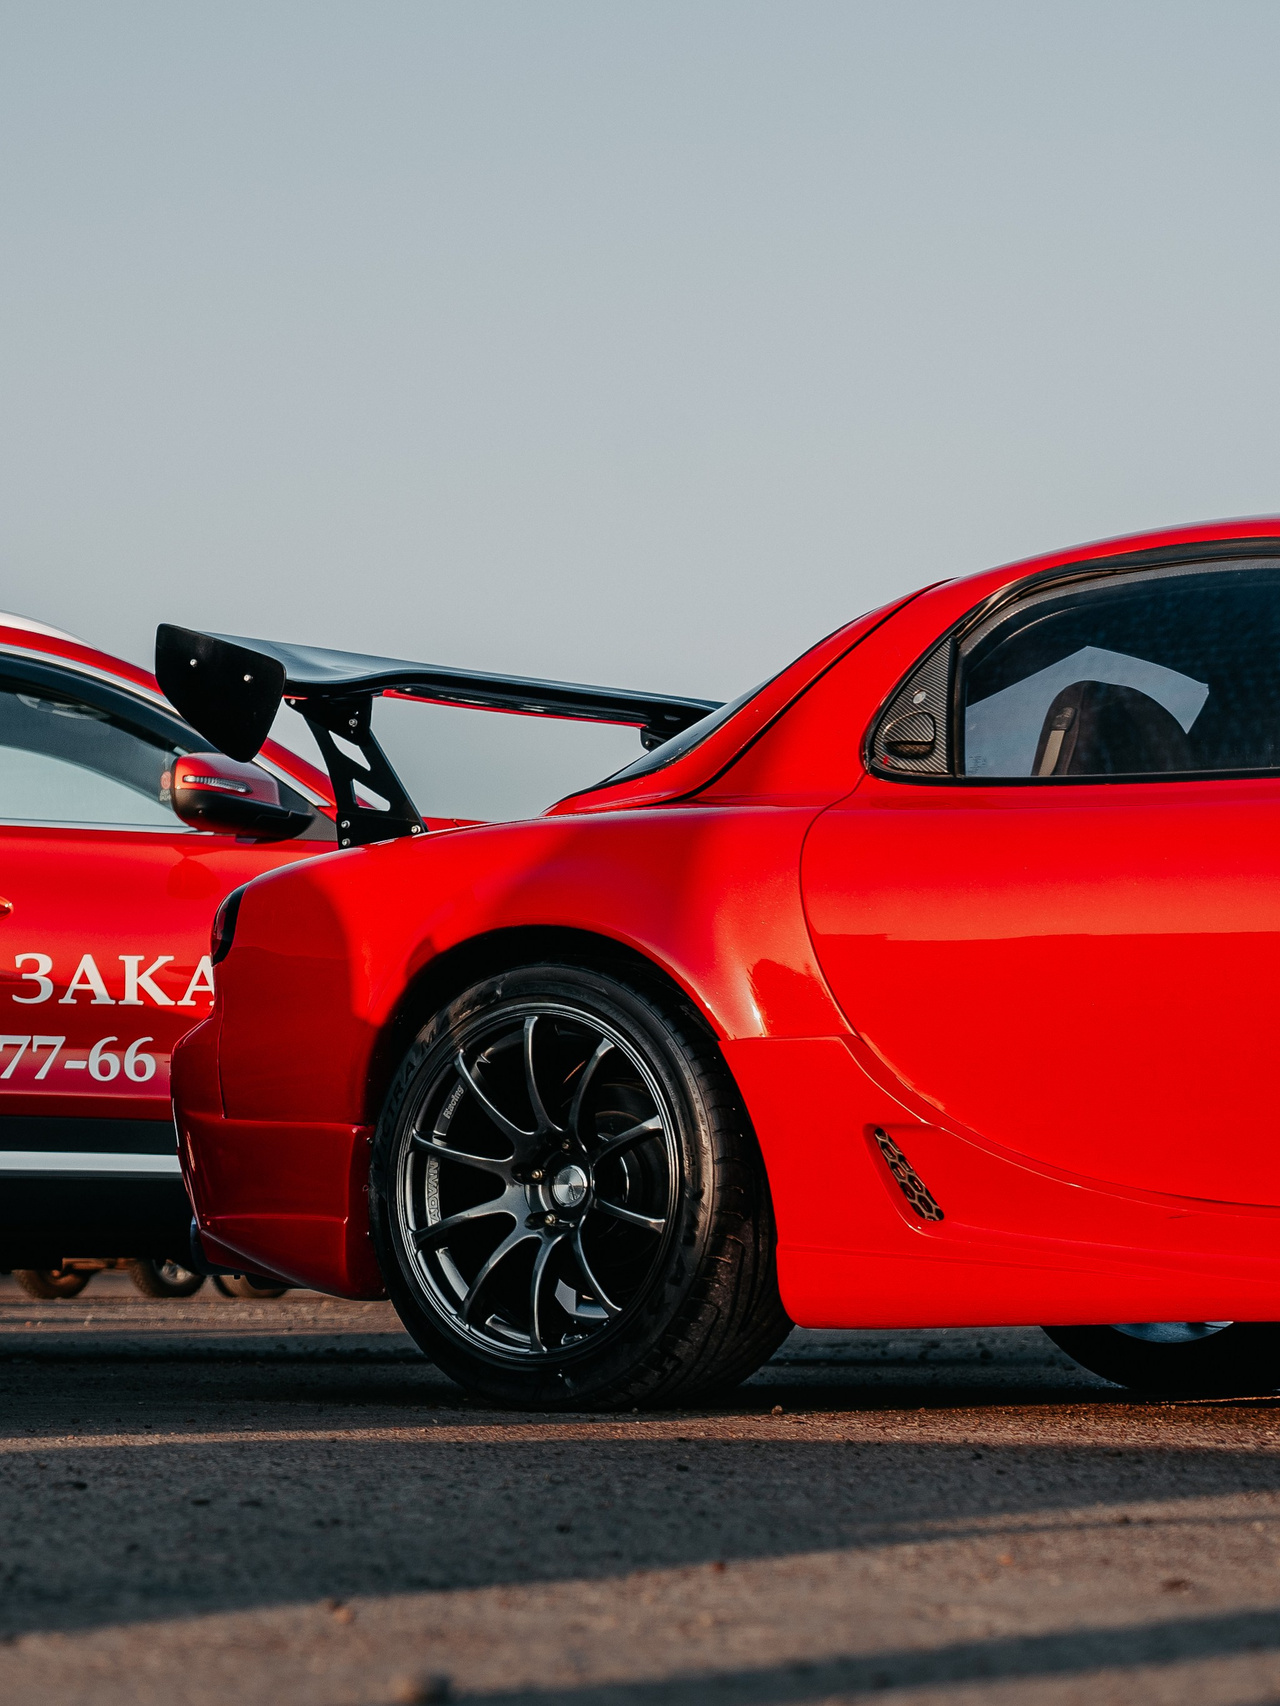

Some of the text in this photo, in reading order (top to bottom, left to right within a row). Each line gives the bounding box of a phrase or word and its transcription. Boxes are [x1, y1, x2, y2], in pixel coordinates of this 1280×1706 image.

[12, 953, 216, 1006] ЗАКА
[427, 1084, 465, 1226] ADVAN Racing
